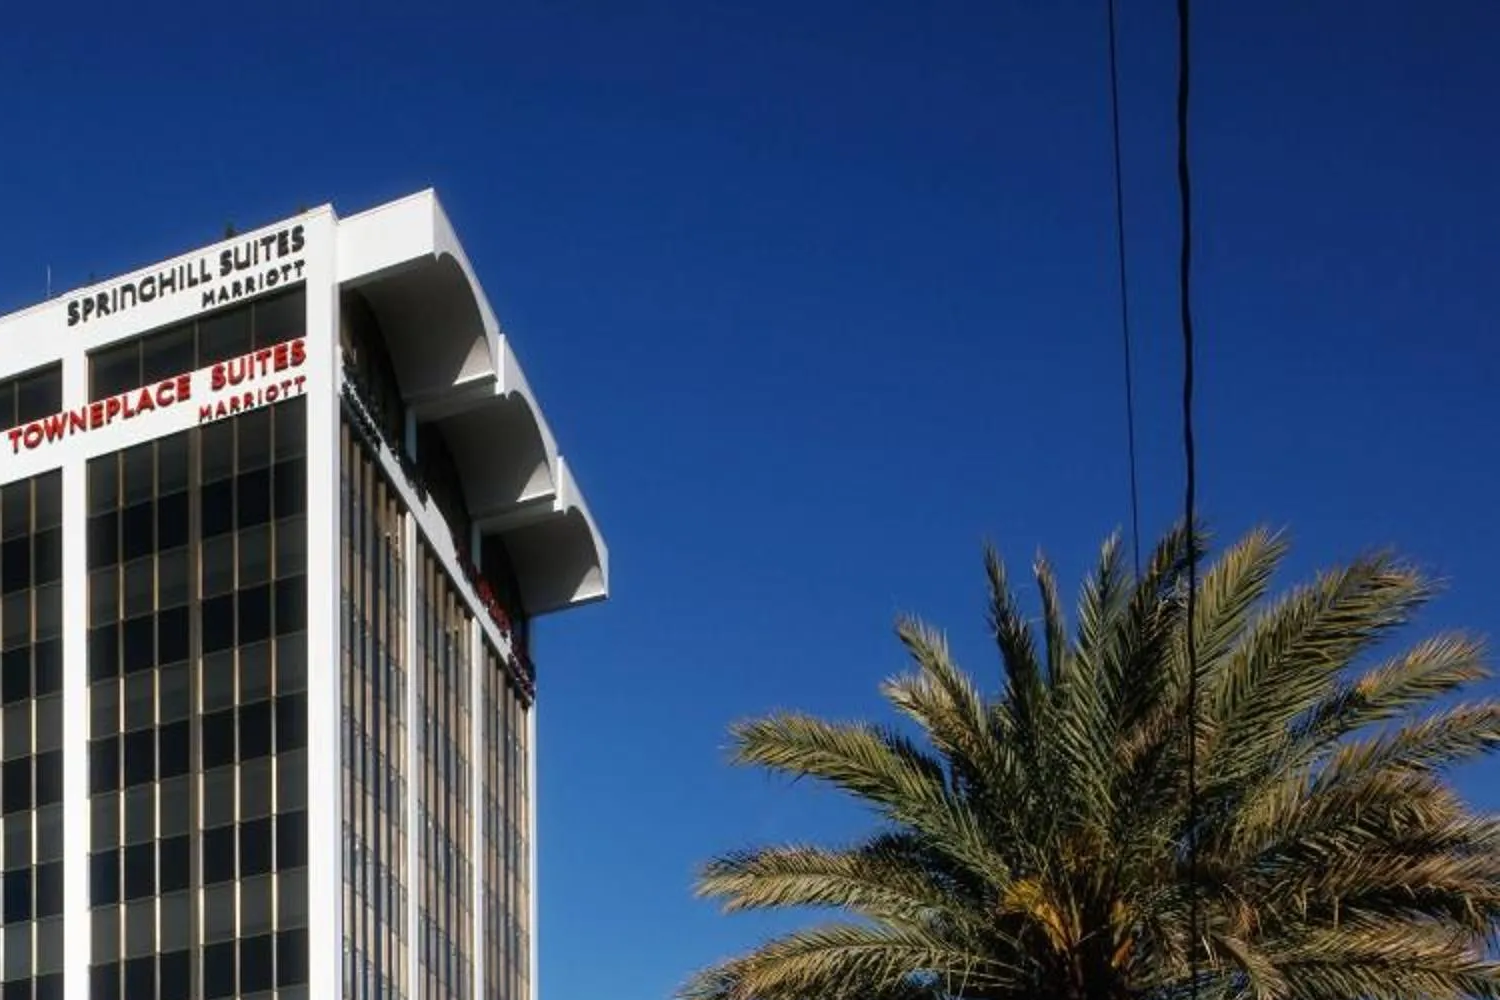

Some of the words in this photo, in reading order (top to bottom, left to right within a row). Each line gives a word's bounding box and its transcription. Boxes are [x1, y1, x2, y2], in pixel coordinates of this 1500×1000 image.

[219, 225, 305, 277] SUITES
[201, 260, 305, 309] MARRIOTT
[7, 375, 191, 455] TOWNEPLACE
[210, 340, 307, 392] SUITES
[199, 375, 307, 424] MARRIOTT
